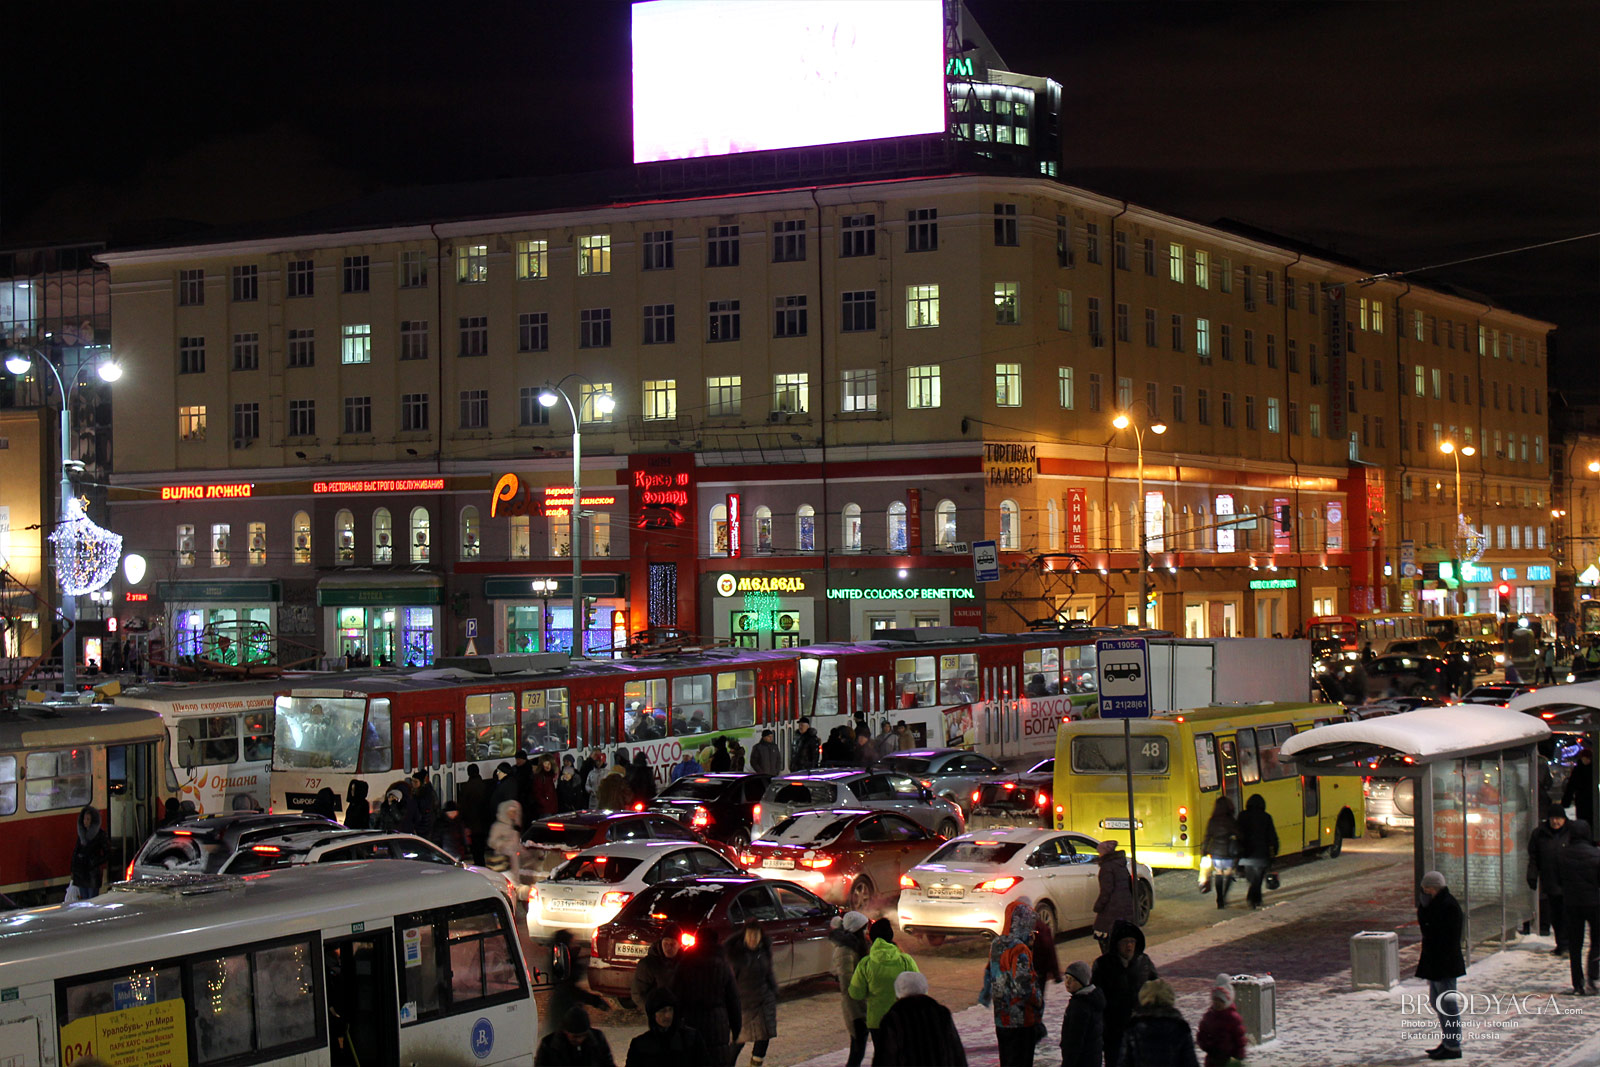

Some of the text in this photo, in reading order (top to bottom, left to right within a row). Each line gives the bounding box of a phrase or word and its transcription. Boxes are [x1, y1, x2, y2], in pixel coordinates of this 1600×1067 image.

[984, 443, 1036, 463] ТОРГОВАЯ
[990, 466, 1033, 484] ГАЛЕРЕЯ
[313, 482, 328, 493] СЕТЬ
[328, 480, 363, 492] РЕСТОРАНОВ
[363, 479, 395, 491] БЫСТРОГО
[545, 487, 574, 497] первое
[545, 507, 569, 518] кафе
[1072, 493, 1081, 544] АНИМЕ
[737, 577, 805, 592] МЕДВЕДЬ
[125, 592, 132, 601] 2
[826, 588, 863, 599] UNITED
[863, 588, 904, 599] COLORS
[904, 587, 920, 599] OF
[953, 609, 982, 617] СКИДКИ
[1117, 641, 1140, 649] 1905г.
[527, 693, 542, 704] 737
[1031, 699, 1073, 718] ВКУСО
[1141, 742, 1160, 757] 48
[211, 775, 257, 792] Ориана
[304, 778, 321, 788] 737
